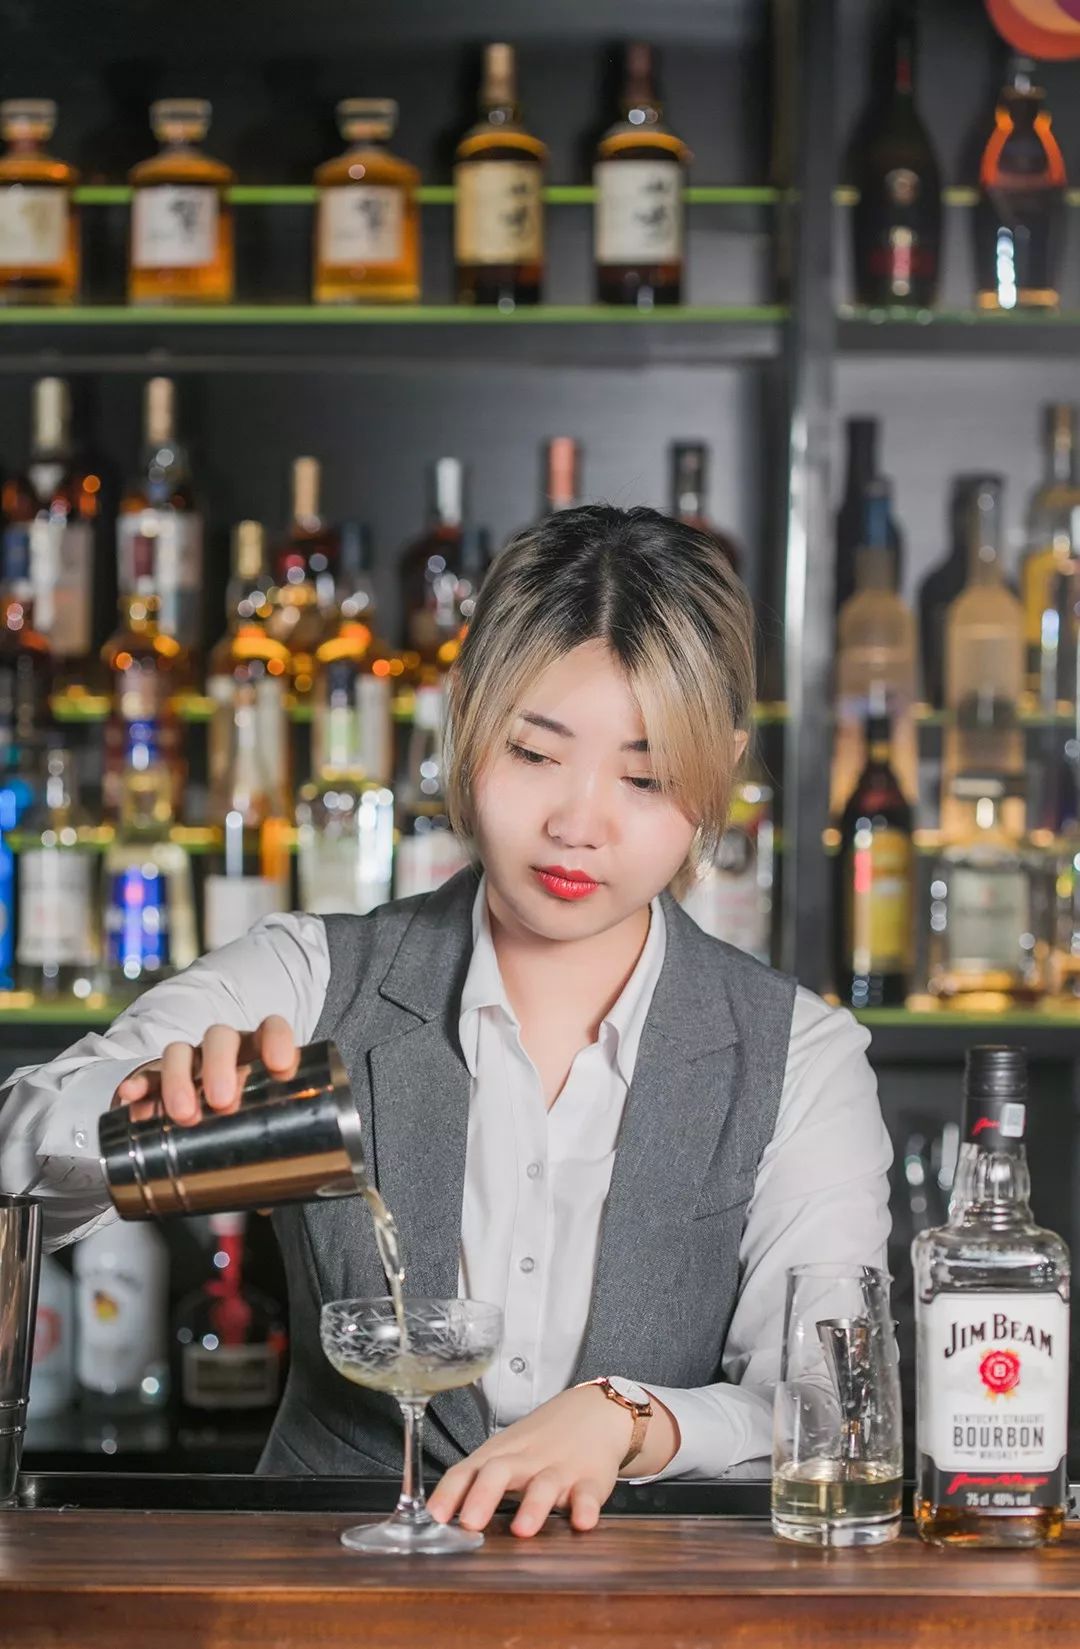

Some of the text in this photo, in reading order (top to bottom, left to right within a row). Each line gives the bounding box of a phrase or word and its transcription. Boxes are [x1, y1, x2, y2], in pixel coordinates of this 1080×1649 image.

[943, 1312, 1054, 1359] JIM BEAM
[953, 1426, 1044, 1448] BOURBON
